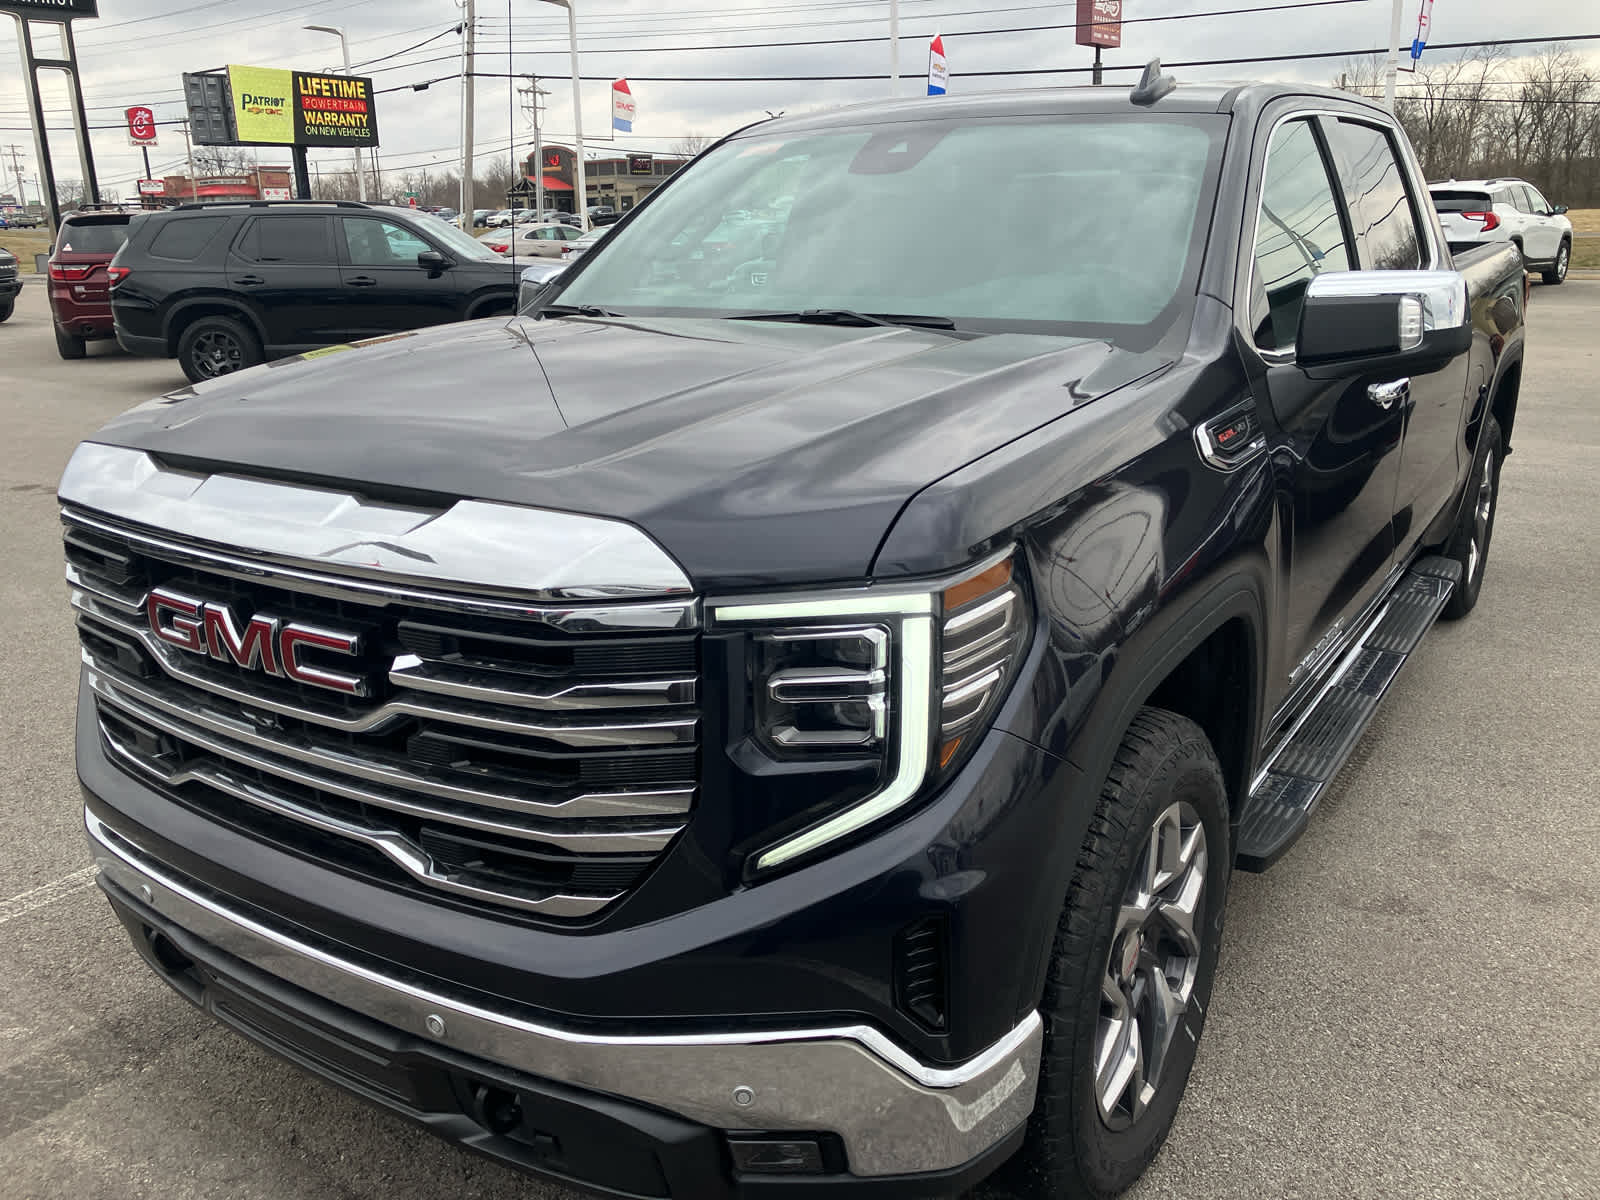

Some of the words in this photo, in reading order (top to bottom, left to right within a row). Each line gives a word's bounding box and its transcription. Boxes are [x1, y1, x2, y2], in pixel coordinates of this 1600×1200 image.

[298, 76, 365, 98] LIFETIME
[242, 93, 285, 110] PATRIOT
[305, 98, 364, 111] POWERTRAIN
[304, 111, 368, 127] WARRANTY
[305, 125, 318, 135] ON
[319, 126, 336, 136] NEW
[337, 127, 370, 137] VEHICLES
[147, 587, 367, 698] GMC
